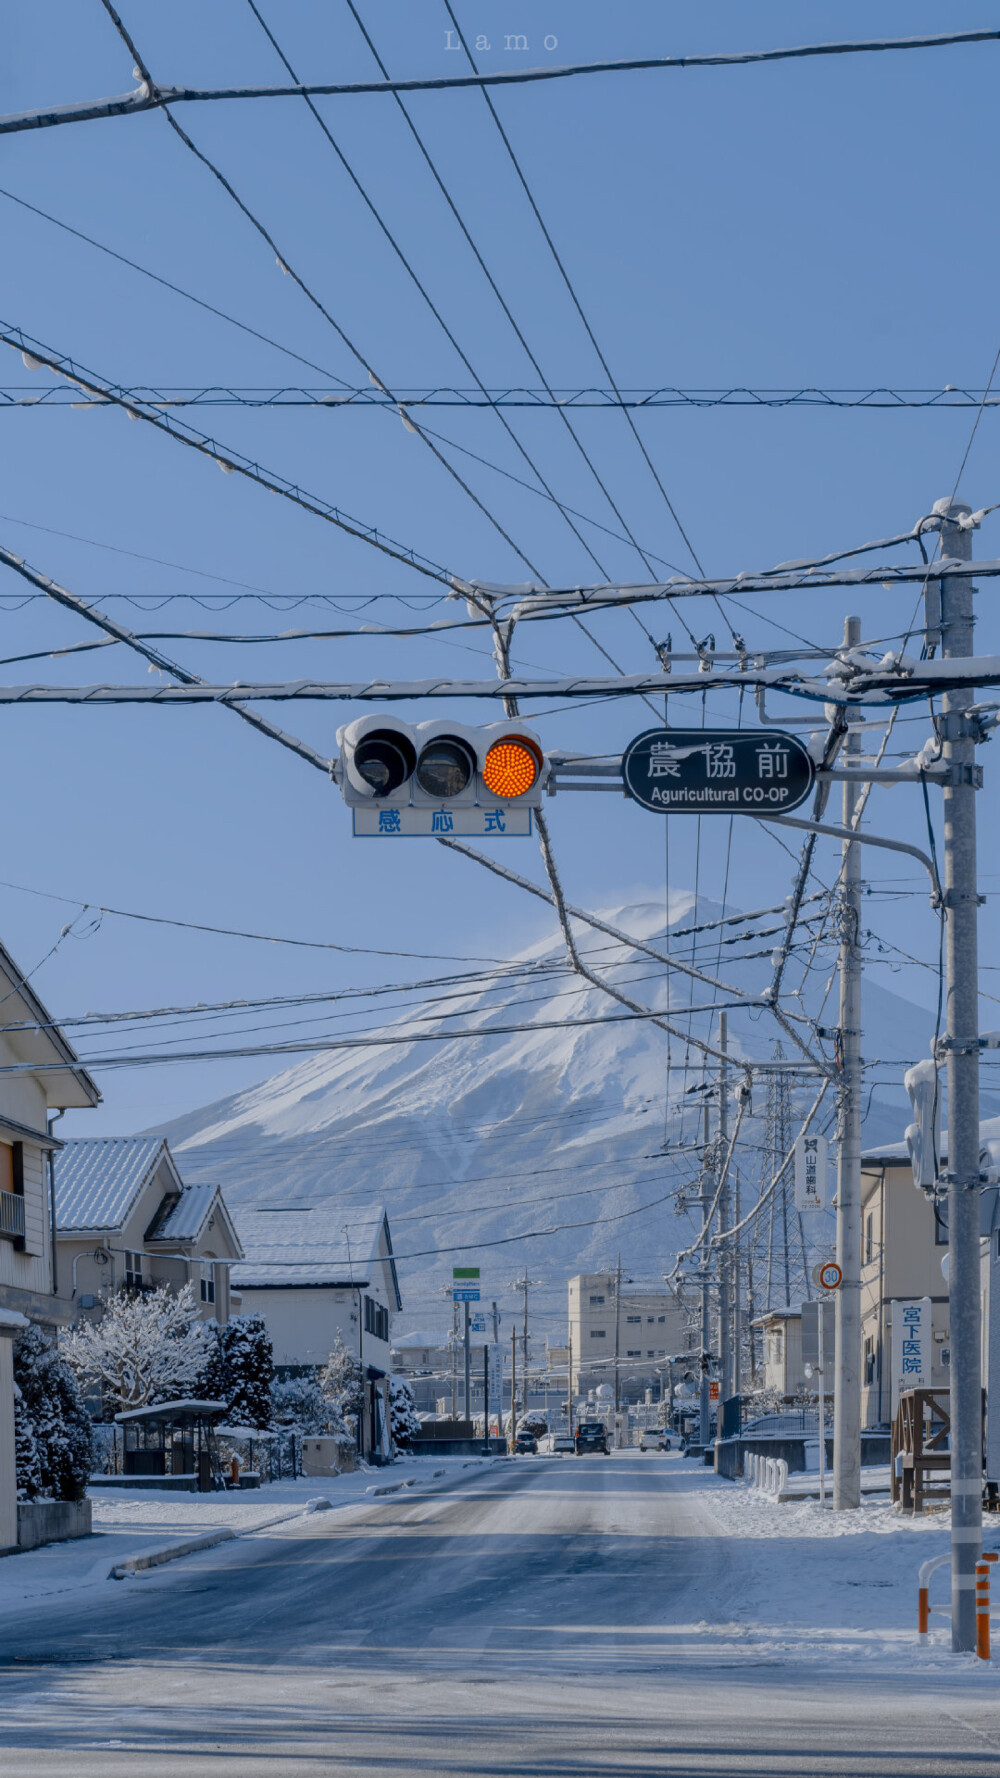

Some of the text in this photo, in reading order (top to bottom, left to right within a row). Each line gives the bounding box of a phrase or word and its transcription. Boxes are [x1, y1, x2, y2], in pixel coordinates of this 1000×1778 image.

[647, 741, 790, 778] 農協前
[651, 787, 789, 804] Aguricultural CO-OP
[378, 808, 506, 833] 感応式
[805, 1155, 817, 1195] 山道歯科
[825, 1269, 838, 1283] 30
[902, 1306, 922, 1375] 宮下医院
